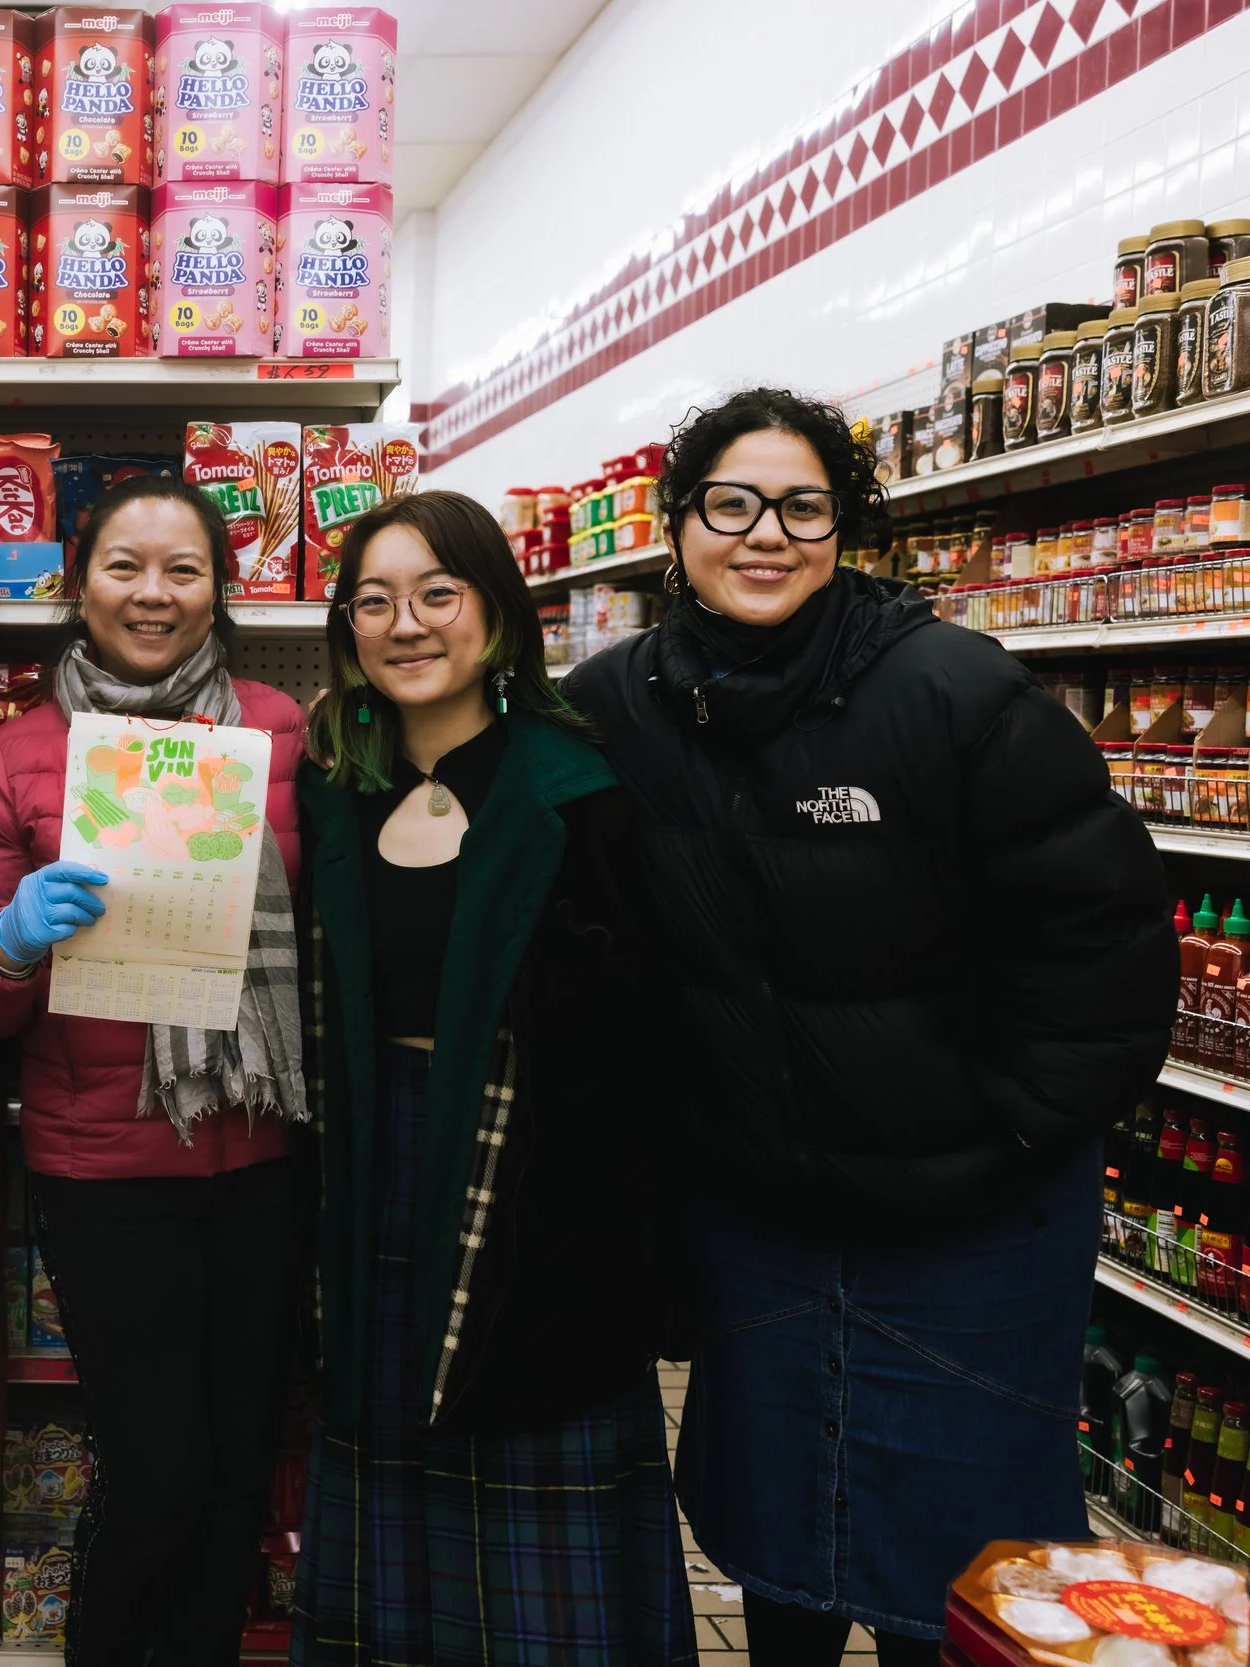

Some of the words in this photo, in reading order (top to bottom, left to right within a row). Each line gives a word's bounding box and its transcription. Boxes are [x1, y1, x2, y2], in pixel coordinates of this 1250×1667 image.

[82, 16, 118, 32] meiji
[198, 10, 233, 25] meiji
[316, 14, 352, 29] meiji
[65, 81, 132, 98] HELLO
[180, 76, 248, 93] HELLO
[299, 79, 367, 97] HELLO
[62, 97, 134, 114] PANDA
[177, 91, 250, 109] PANDA
[295, 95, 370, 112] PANDA
[78, 116, 116, 124] Chocolate
[192, 111, 234, 120] Strawberry
[311, 114, 352, 122] Strawberry
[66, 136, 82, 148] 10
[181, 131, 197, 143] 10
[300, 134, 316, 146] 10
[64, 148, 83, 156] Bags
[179, 144, 199, 152] Bags
[298, 146, 317, 154] Bags
[75, 192, 111, 208] meiji
[193, 188, 229, 203] meiji
[318, 190, 353, 206] meiji
[60, 257, 127, 274] HELLO
[176, 253, 244, 270] HELLO
[301, 255, 368, 272] HELLO
[57, 272, 129, 289] PANDA
[172, 268, 246, 286] PANDA
[298, 270, 371, 287] PANDA
[187, 288, 229, 296] Strawberry
[62, 310, 78, 322] 10
[177, 307, 193, 319] 10
[302, 309, 318, 321] 10
[60, 322, 79, 330] Bags
[175, 320, 194, 328] Bags
[300, 321, 319, 329] Bags
[267, 456, 296, 468] トマトの
[192, 462, 255, 481] Tomato
[309, 461, 373, 483] Tomato
[214, 484, 261, 515] RETZ
[146, 737, 195, 762] SUN
[148, 760, 195, 782] VIN
[818, 786, 849, 799] THE
[796, 799, 851, 813] NORTH
[813, 811, 853, 824] FACE
